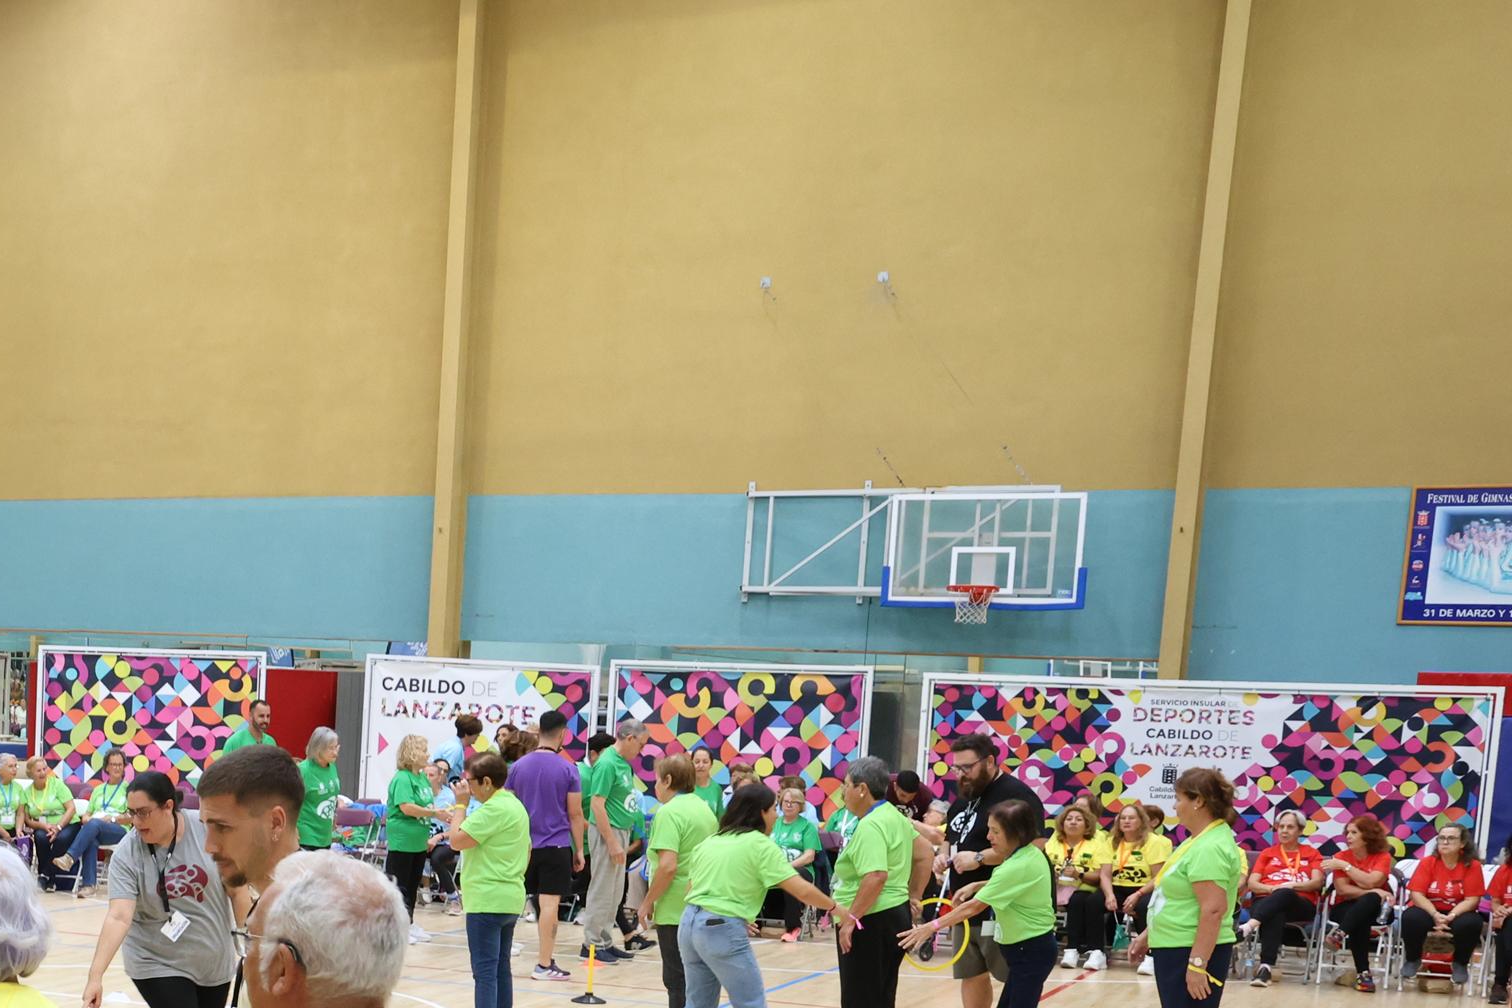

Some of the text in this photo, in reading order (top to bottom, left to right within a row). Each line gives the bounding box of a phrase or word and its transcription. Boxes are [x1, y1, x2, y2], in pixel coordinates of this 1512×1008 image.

[1427, 493, 1465, 504] FESTIVAL
[1467, 494, 1479, 504] DE
[1423, 609, 1435, 617] 31
[1439, 609, 1453, 617] DE
[1456, 609, 1496, 618] MARZO
[1498, 609, 1506, 618] Y
[382, 677, 498, 697] CABILDO DE
[1133, 707, 1255, 726] DEPORTES
[1146, 728, 1239, 742] CABILDO DE
[1130, 742, 1252, 760] LANZAROTE
